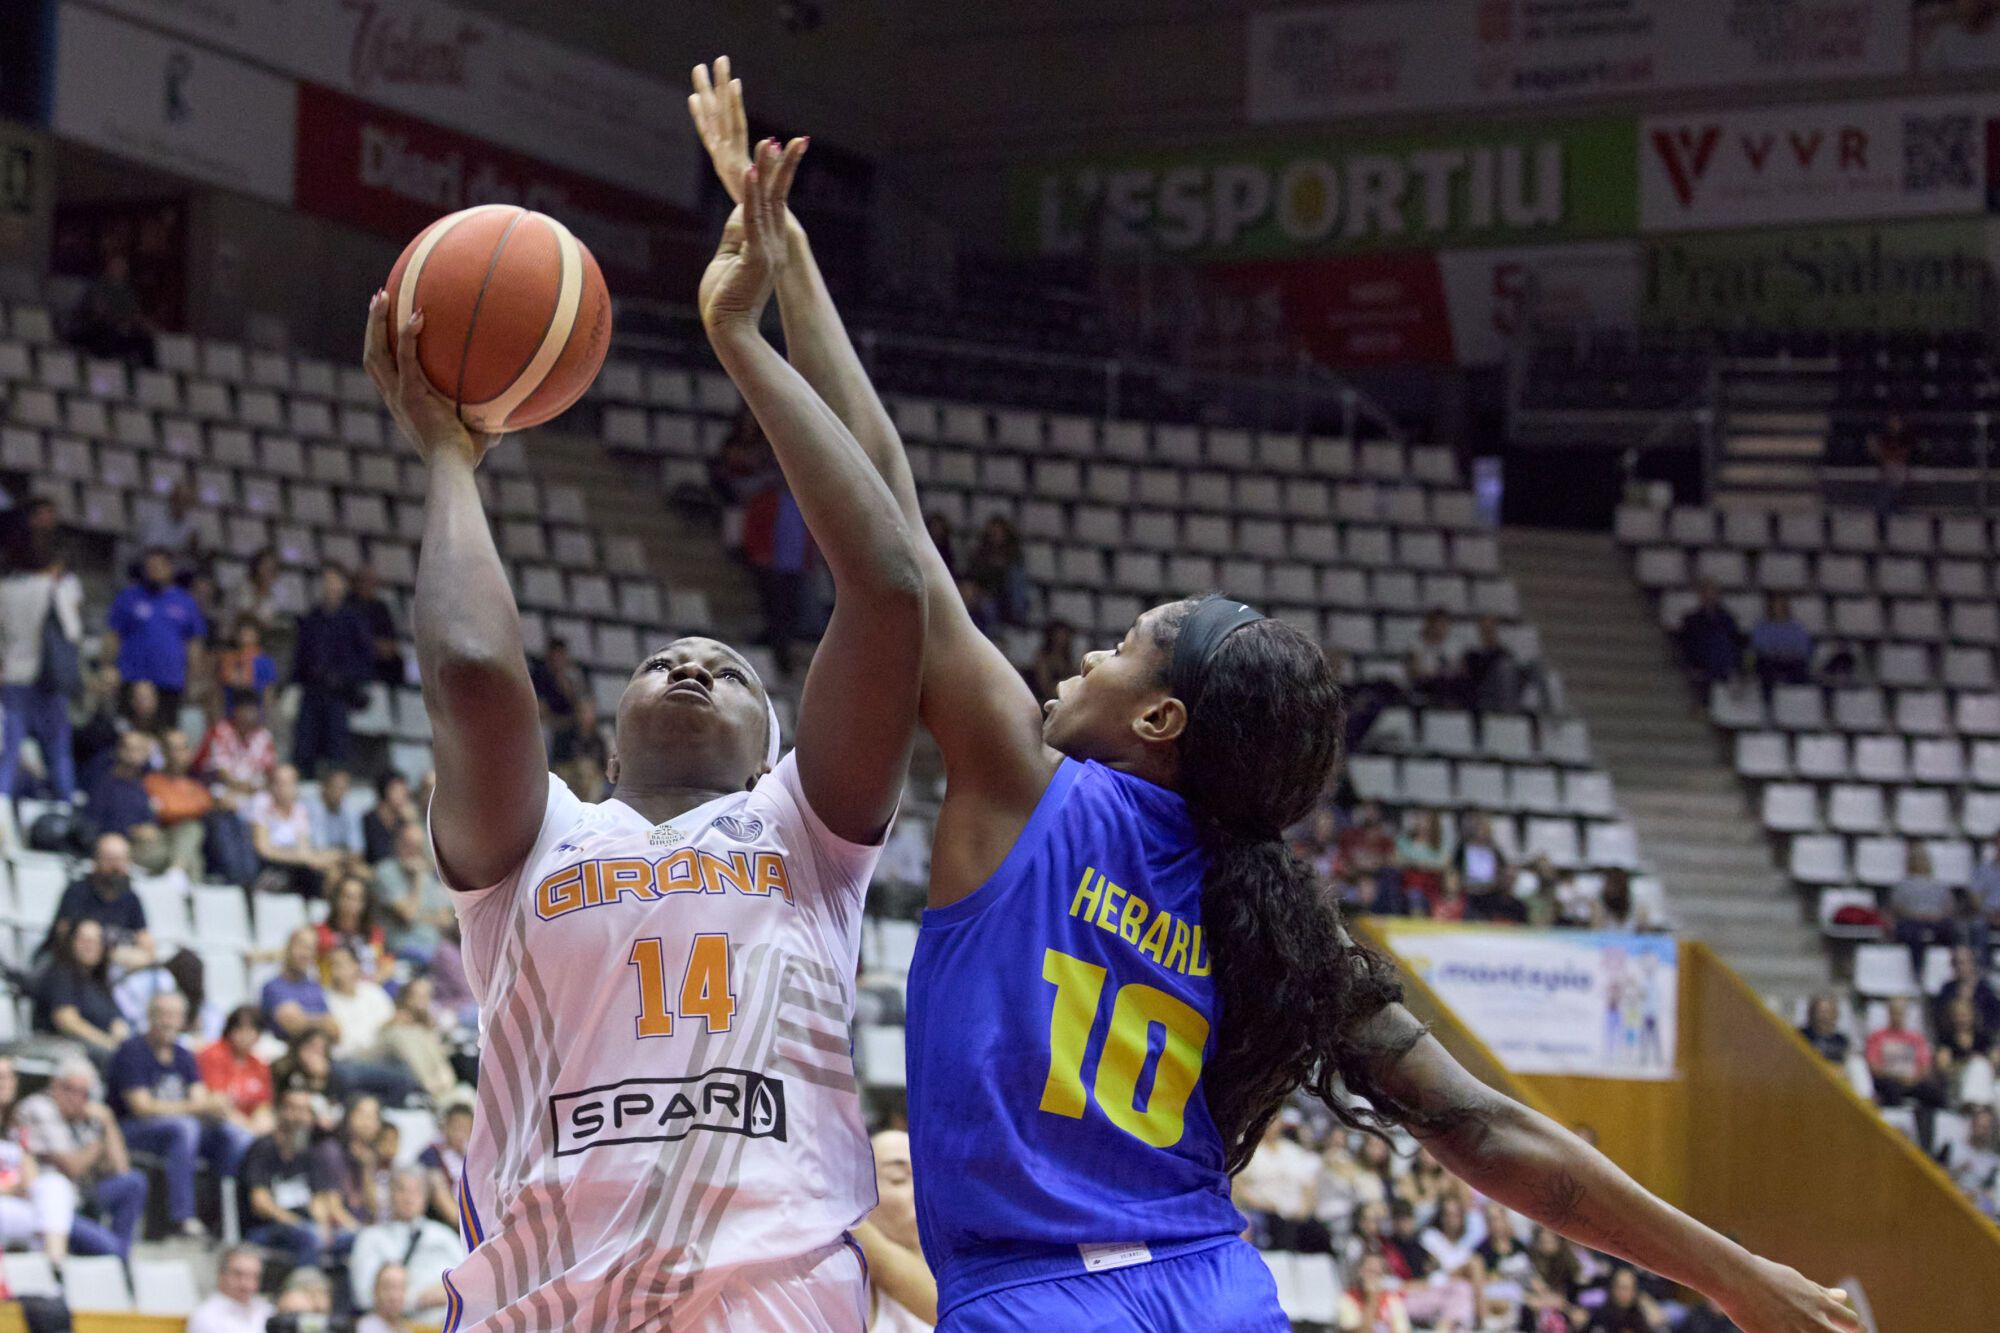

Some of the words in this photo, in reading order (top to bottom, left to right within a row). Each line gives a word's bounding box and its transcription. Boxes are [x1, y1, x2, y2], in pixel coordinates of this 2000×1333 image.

[1039, 142, 1565, 255] L'ESPORTIU
[535, 846, 795, 922] GIRONA
[627, 933, 737, 1040] 14
[1039, 947, 1210, 1149] 10
[571, 1082, 741, 1140] SPAR
